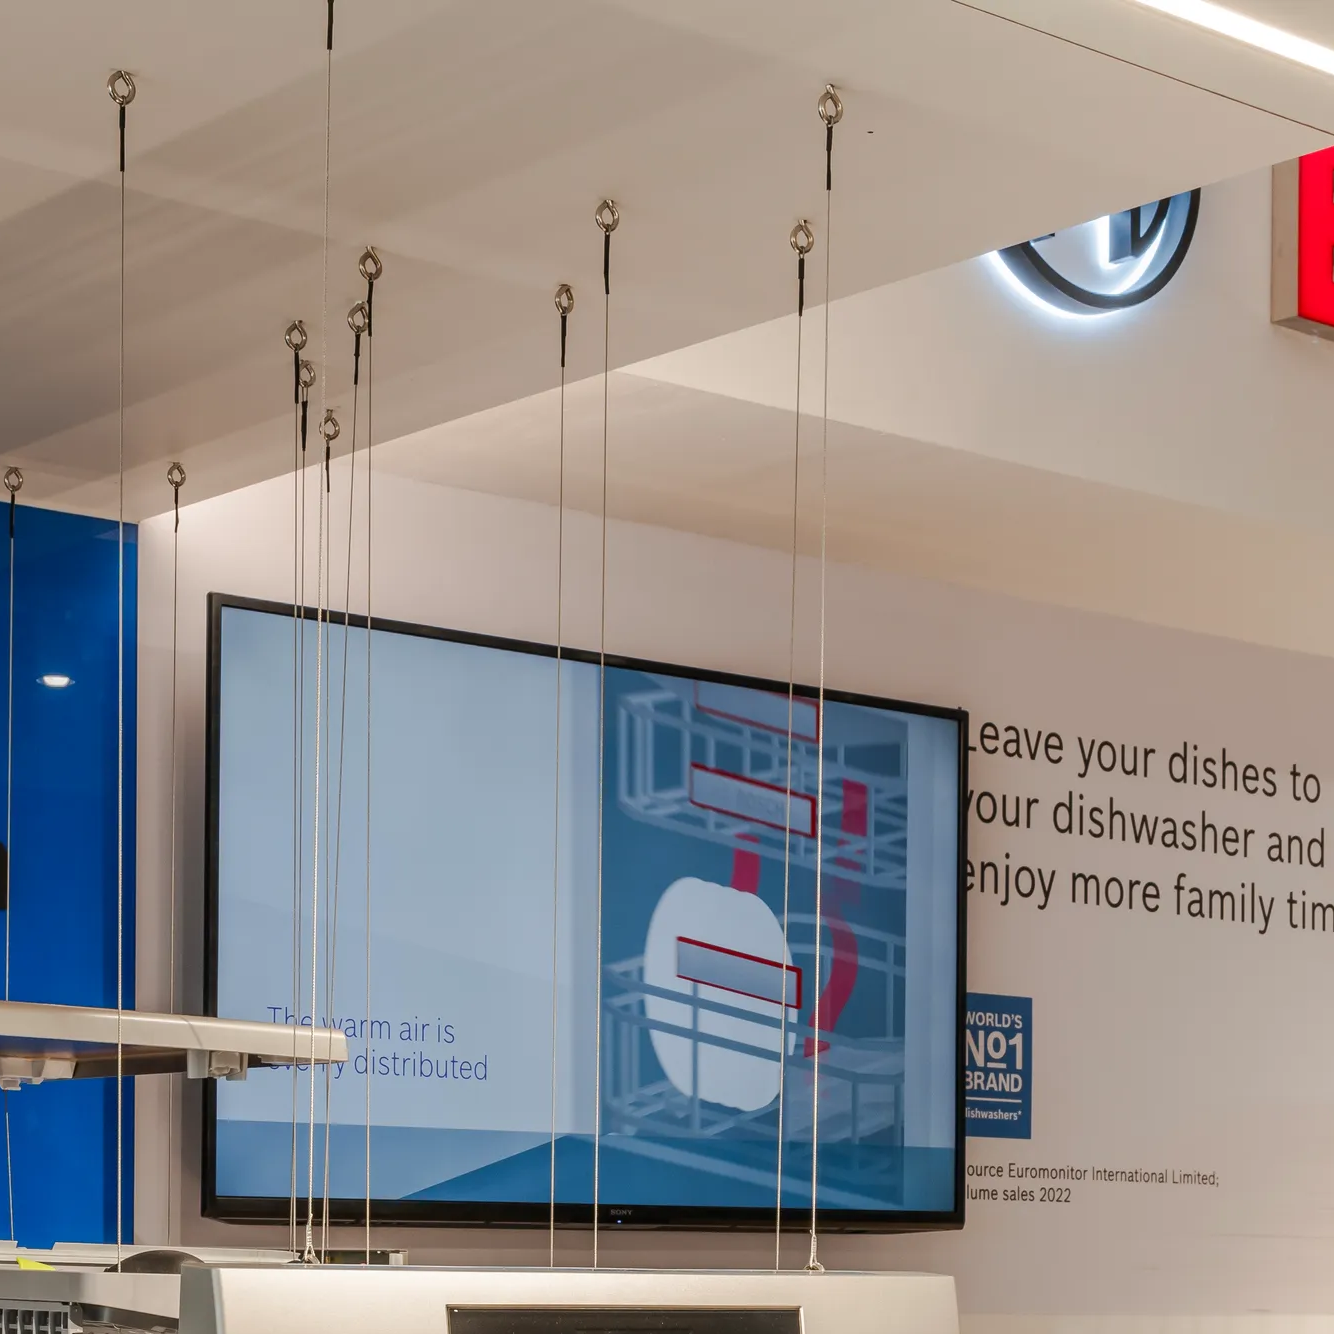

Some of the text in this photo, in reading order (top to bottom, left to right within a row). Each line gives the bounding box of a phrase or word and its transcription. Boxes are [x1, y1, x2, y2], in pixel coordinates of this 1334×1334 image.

[968, 721, 1321, 803] eave your dishes to
[1053, 790, 1255, 857] dishwasher
[1267, 827, 1325, 868] and
[1071, 871, 1161, 913] more
[1174, 872, 1275, 935] family
[399, 1016, 429, 1042] air
[437, 1017, 455, 1044] is
[966, 1011, 1023, 1029] WORLD'S
[354, 1049, 488, 1081] distributed
[965, 1071, 1023, 1093] BRAND
[966, 1163, 1004, 1178] ource
[1008, 1162, 1088, 1181] Euromonitor
[1092, 1166, 1168, 1184] International
[1002, 1185, 1035, 1203] sales
[1039, 1187, 1071, 1203] 2022
